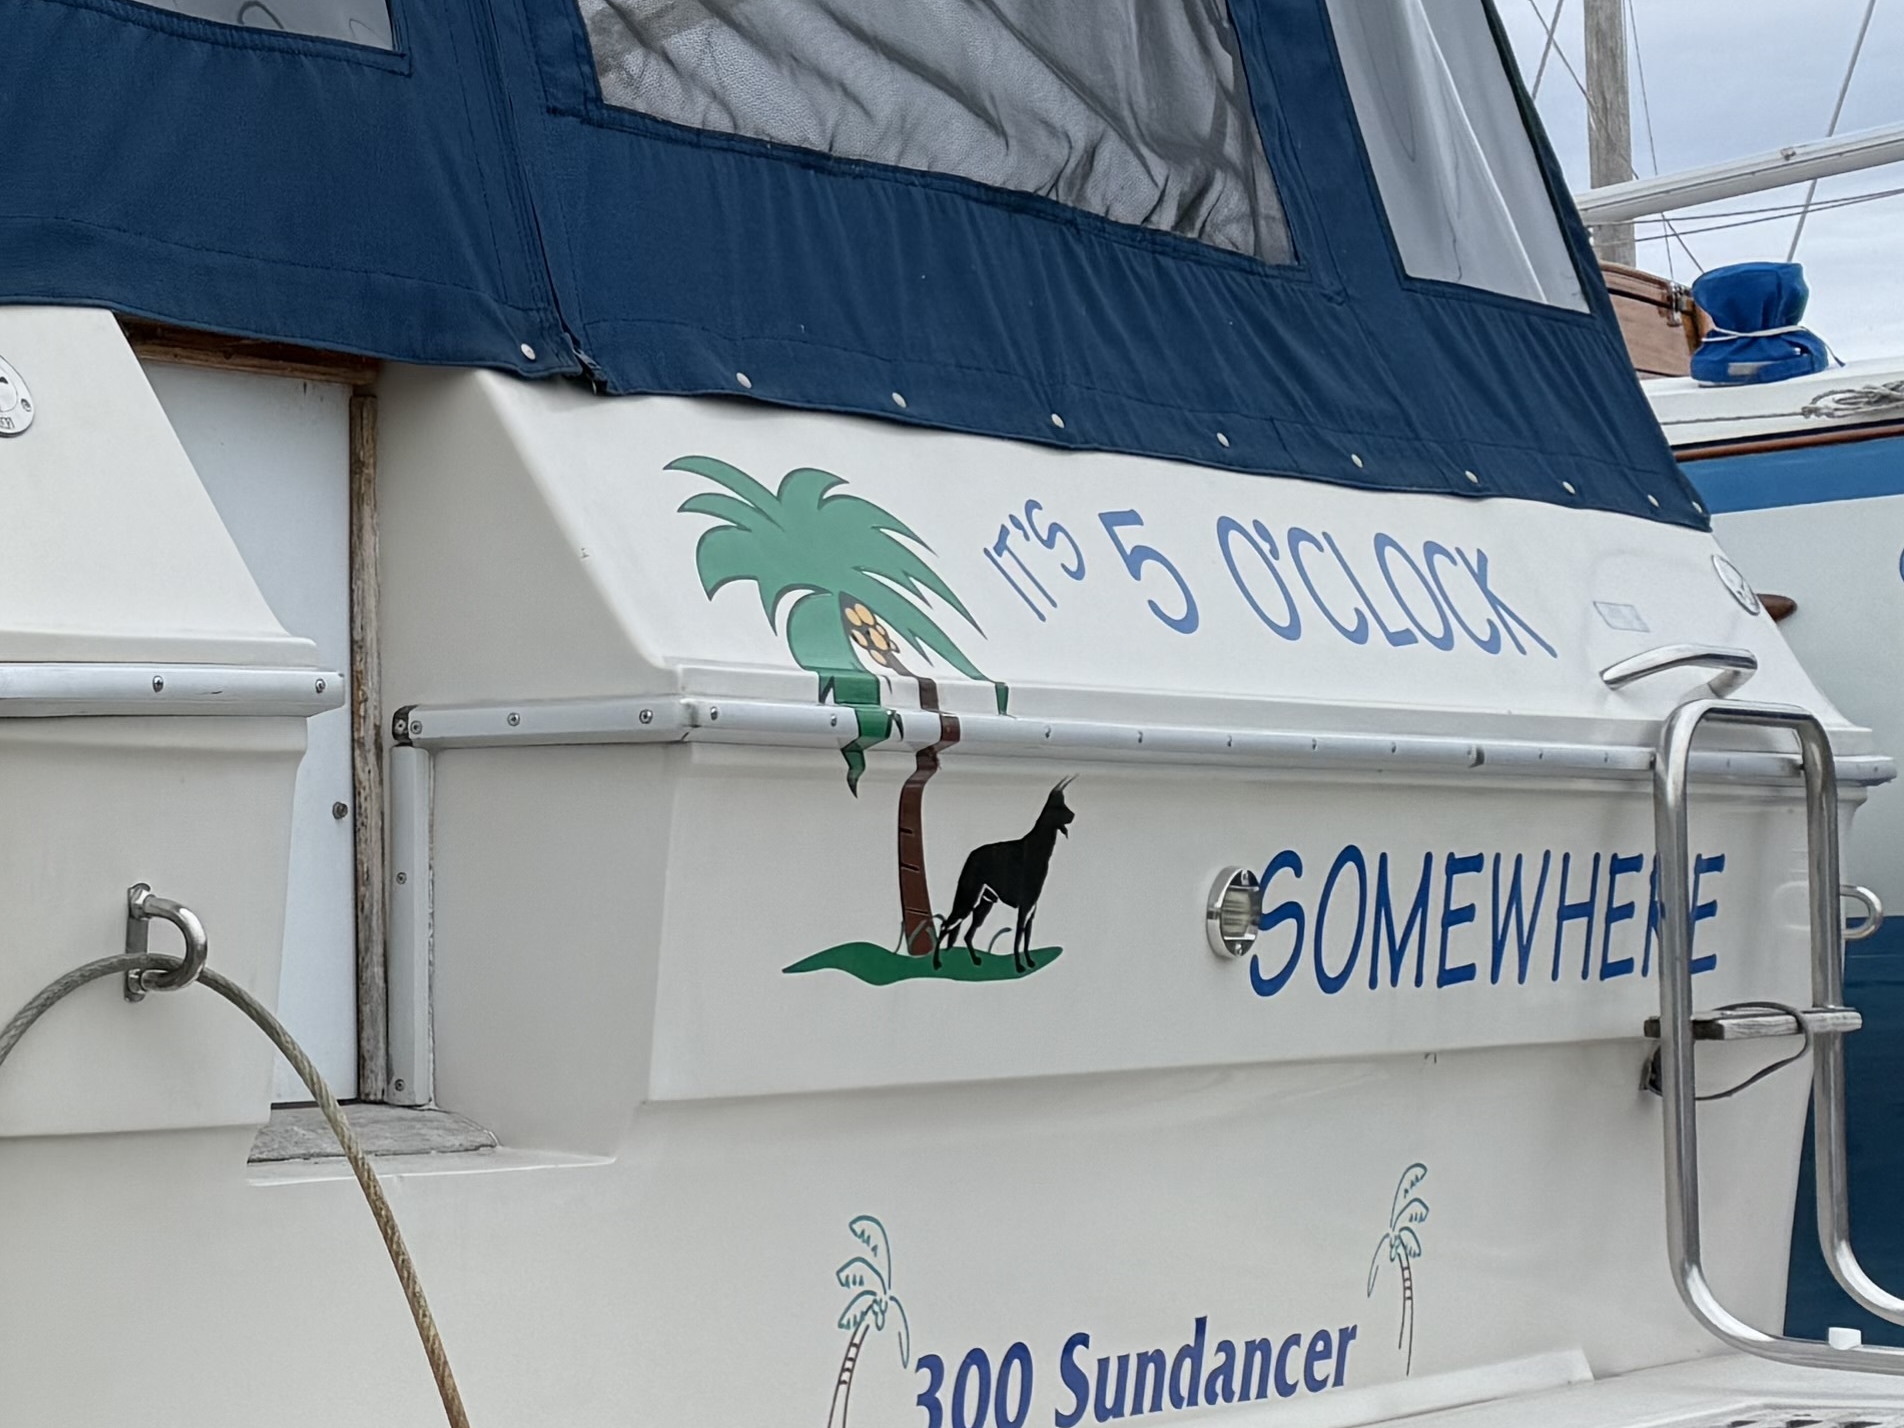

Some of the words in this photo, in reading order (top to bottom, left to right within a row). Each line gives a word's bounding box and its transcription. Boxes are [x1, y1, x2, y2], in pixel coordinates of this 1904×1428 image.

[982, 498, 1086, 623] IT'S
[1097, 508, 1200, 635] 5
[1216, 515, 1558, 659] O'CLOCK
